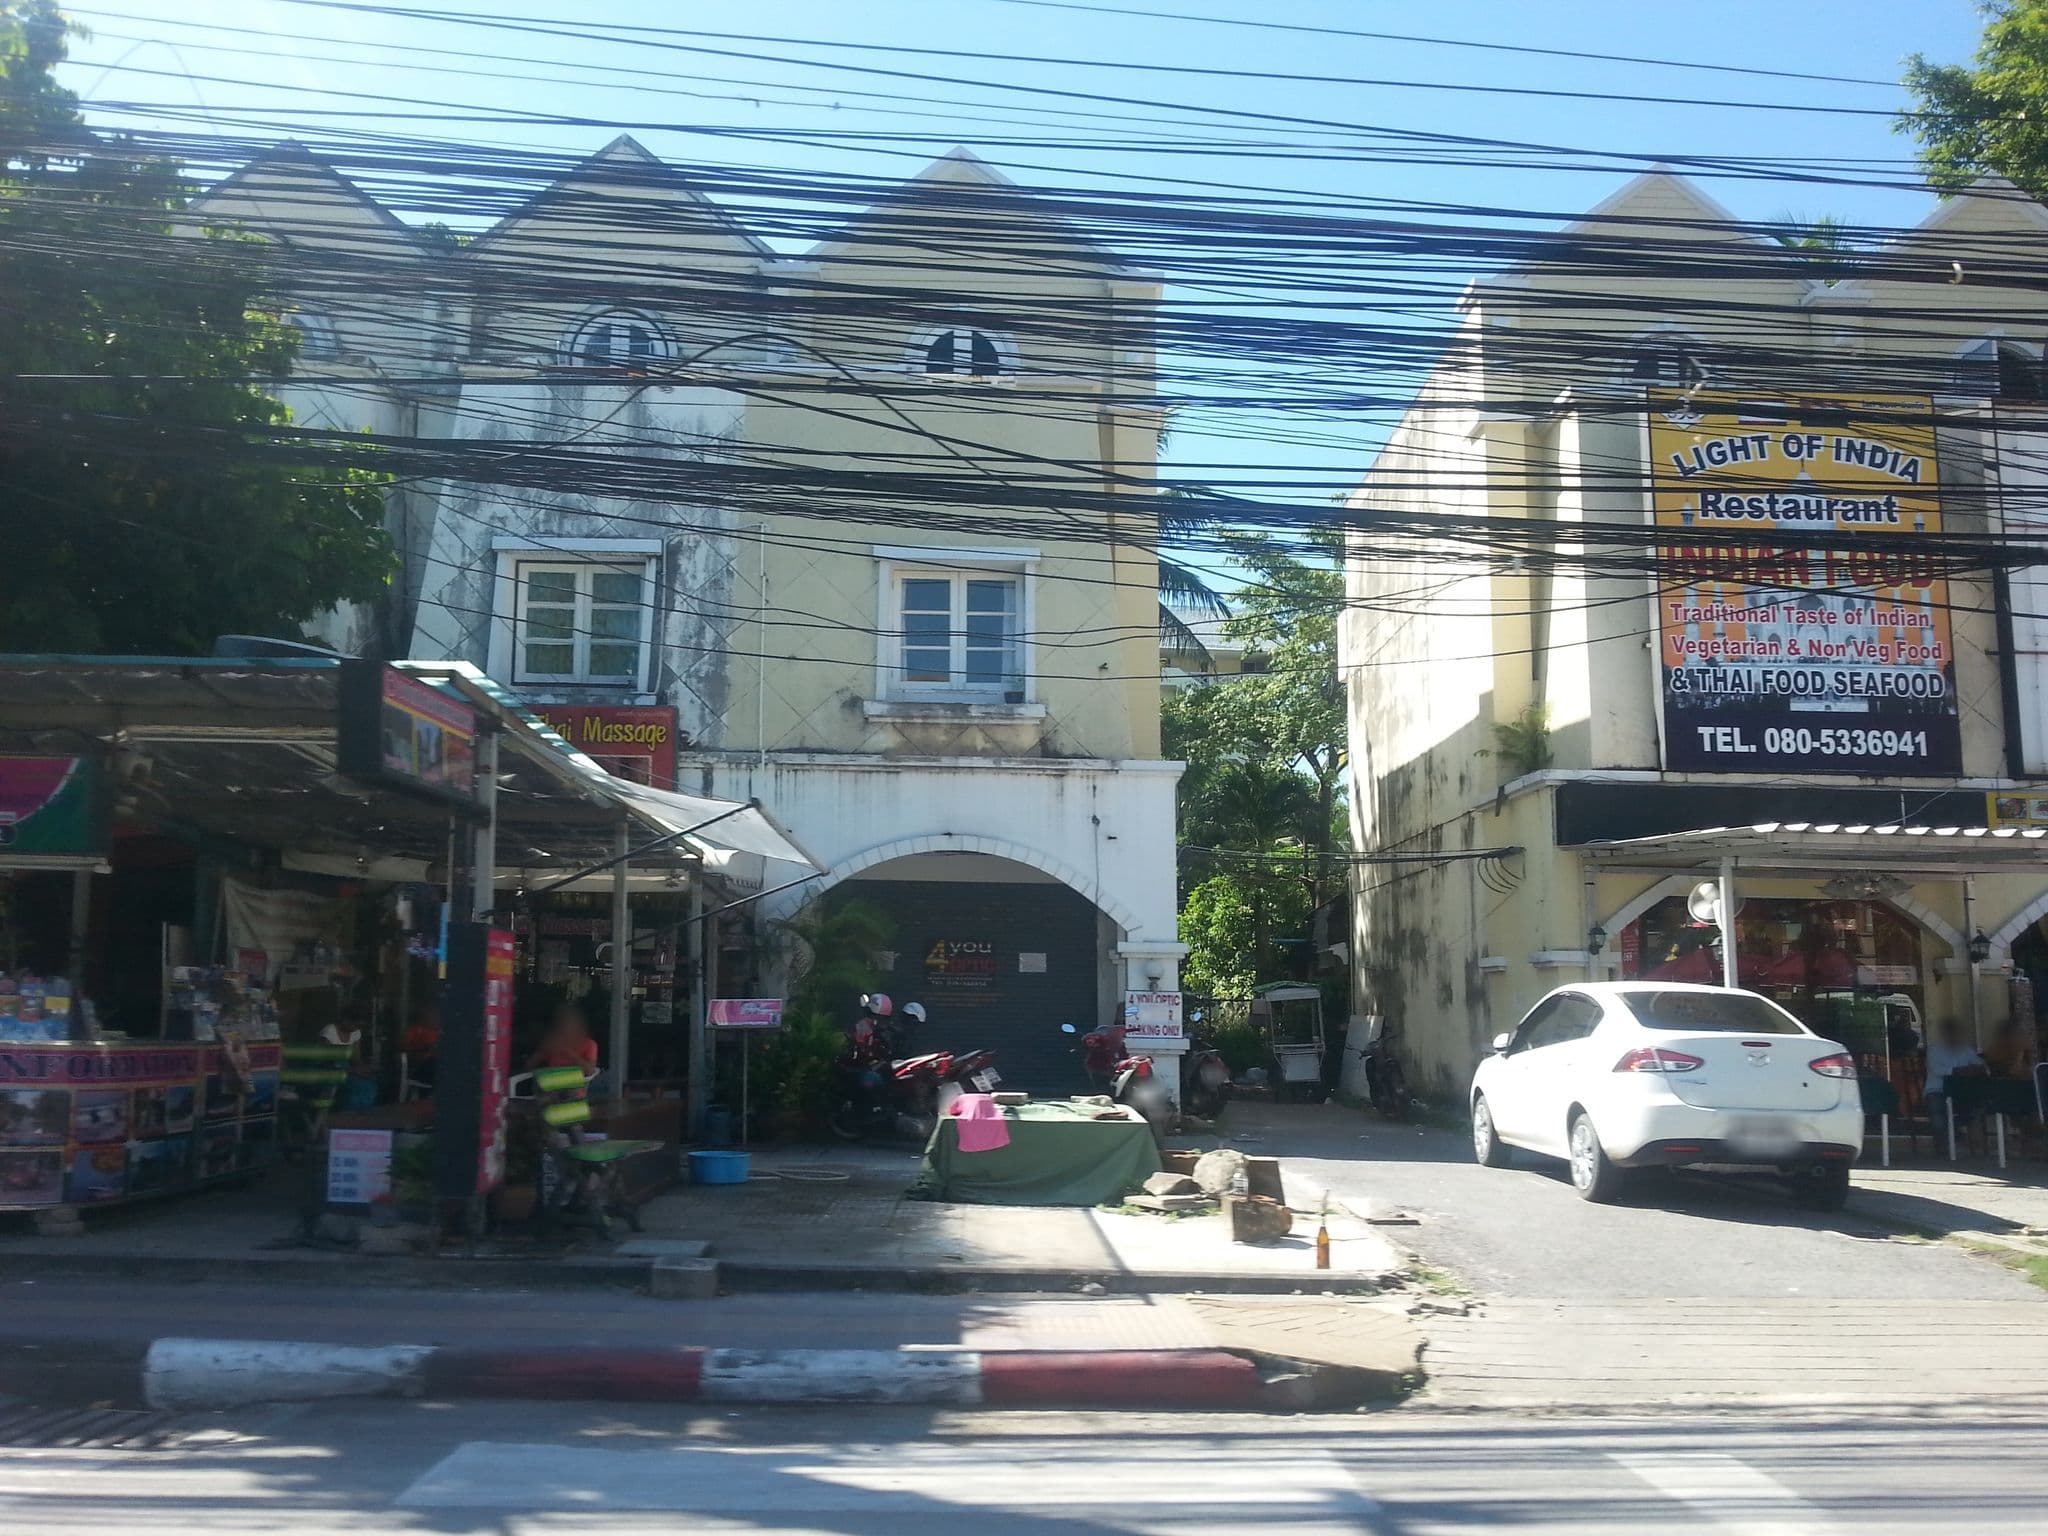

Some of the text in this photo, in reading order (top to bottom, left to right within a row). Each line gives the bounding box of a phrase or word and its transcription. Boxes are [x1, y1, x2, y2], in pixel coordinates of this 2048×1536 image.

[1673, 434, 1922, 482] LIGHT OF INDIA
[1698, 491, 1898, 523] Restaurant
[1670, 603, 1930, 627] Traditional Taste of Indian
[1671, 635, 1943, 662] Vegetarian & Non Veg Food
[1672, 667, 1944, 697] & THAI FOOD SEAFOOD
[583, 716, 666, 752] Massage
[1698, 726, 1928, 756] TEL. 080-5336941
